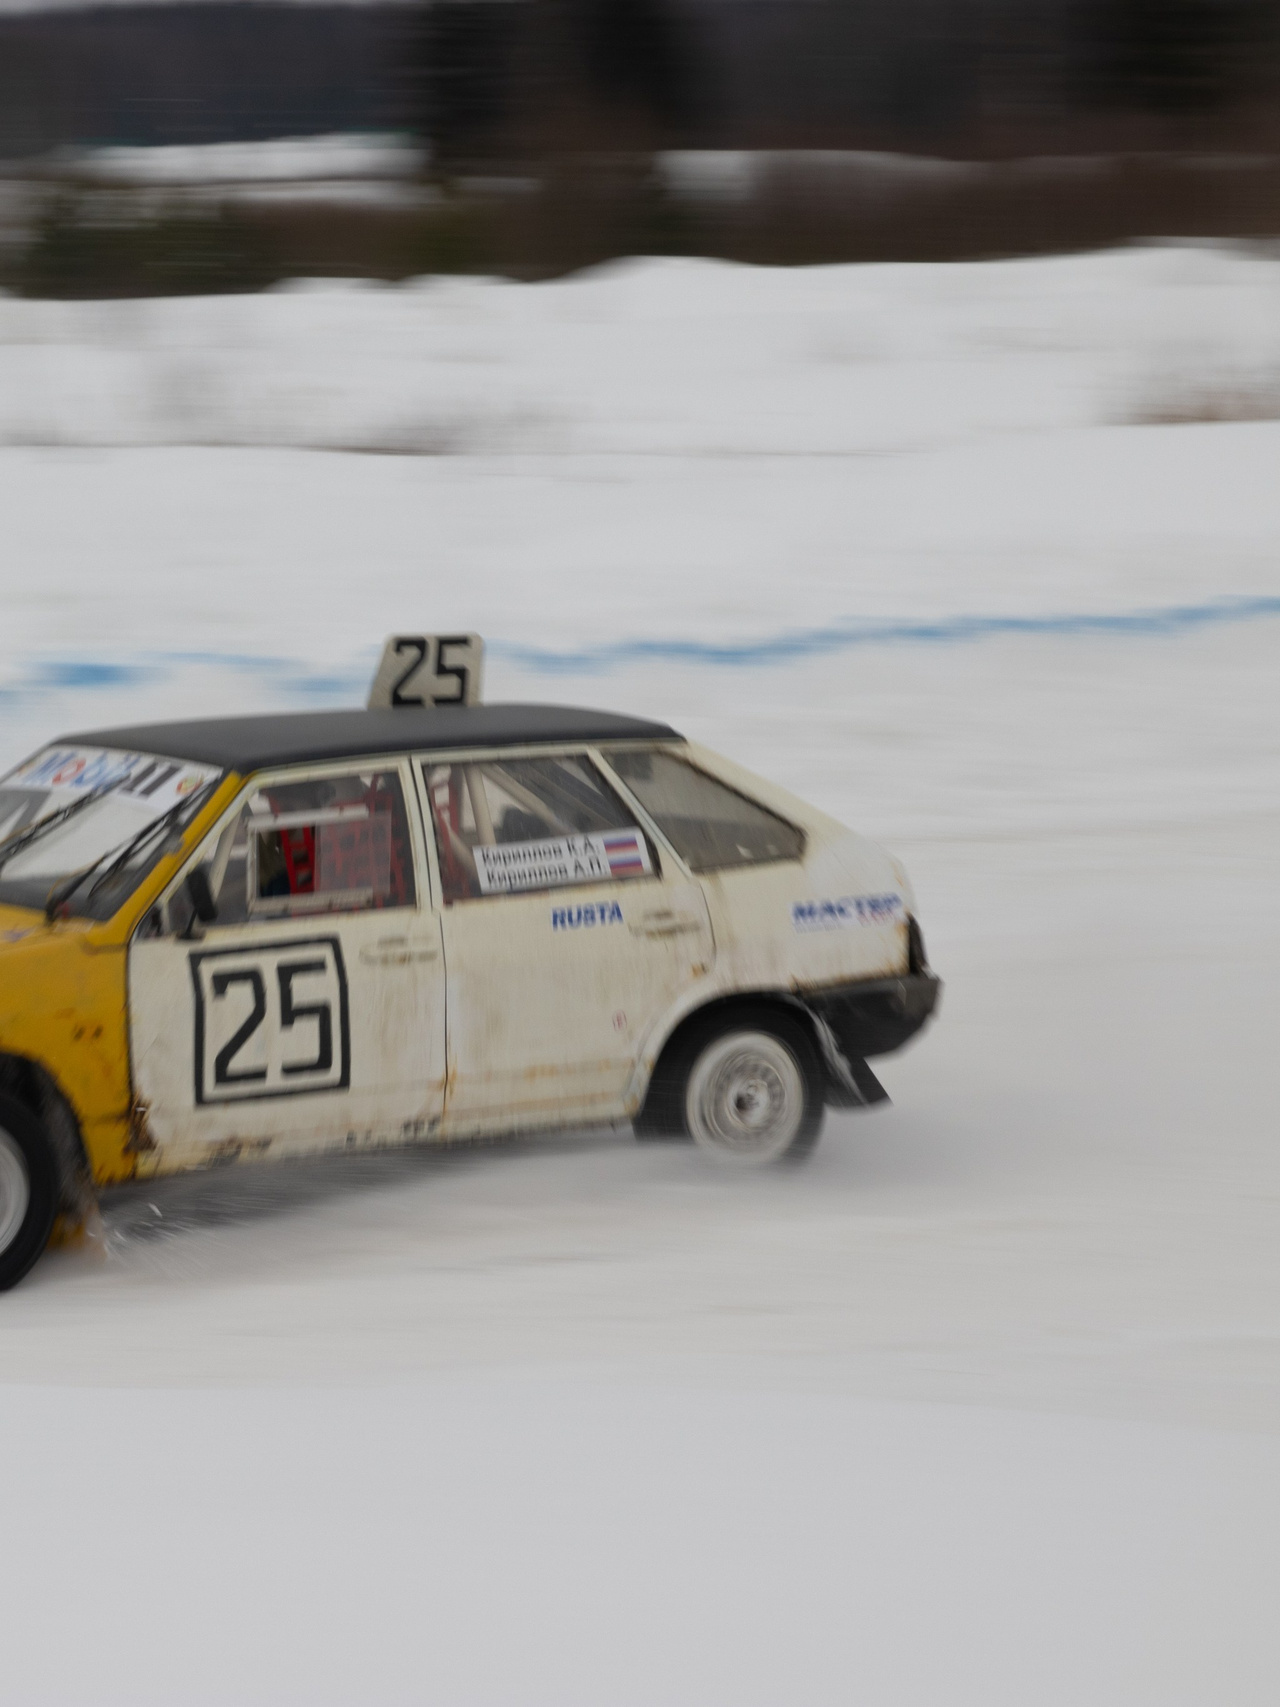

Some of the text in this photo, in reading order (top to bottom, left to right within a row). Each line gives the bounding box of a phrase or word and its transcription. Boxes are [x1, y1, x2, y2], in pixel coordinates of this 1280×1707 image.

[391, 635, 471, 708] 25
[481, 842, 563, 868] Кириллов
[486, 863, 568, 890] Кириллов
[552, 900, 624, 930] RUSTA
[211, 957, 333, 1087] 25
